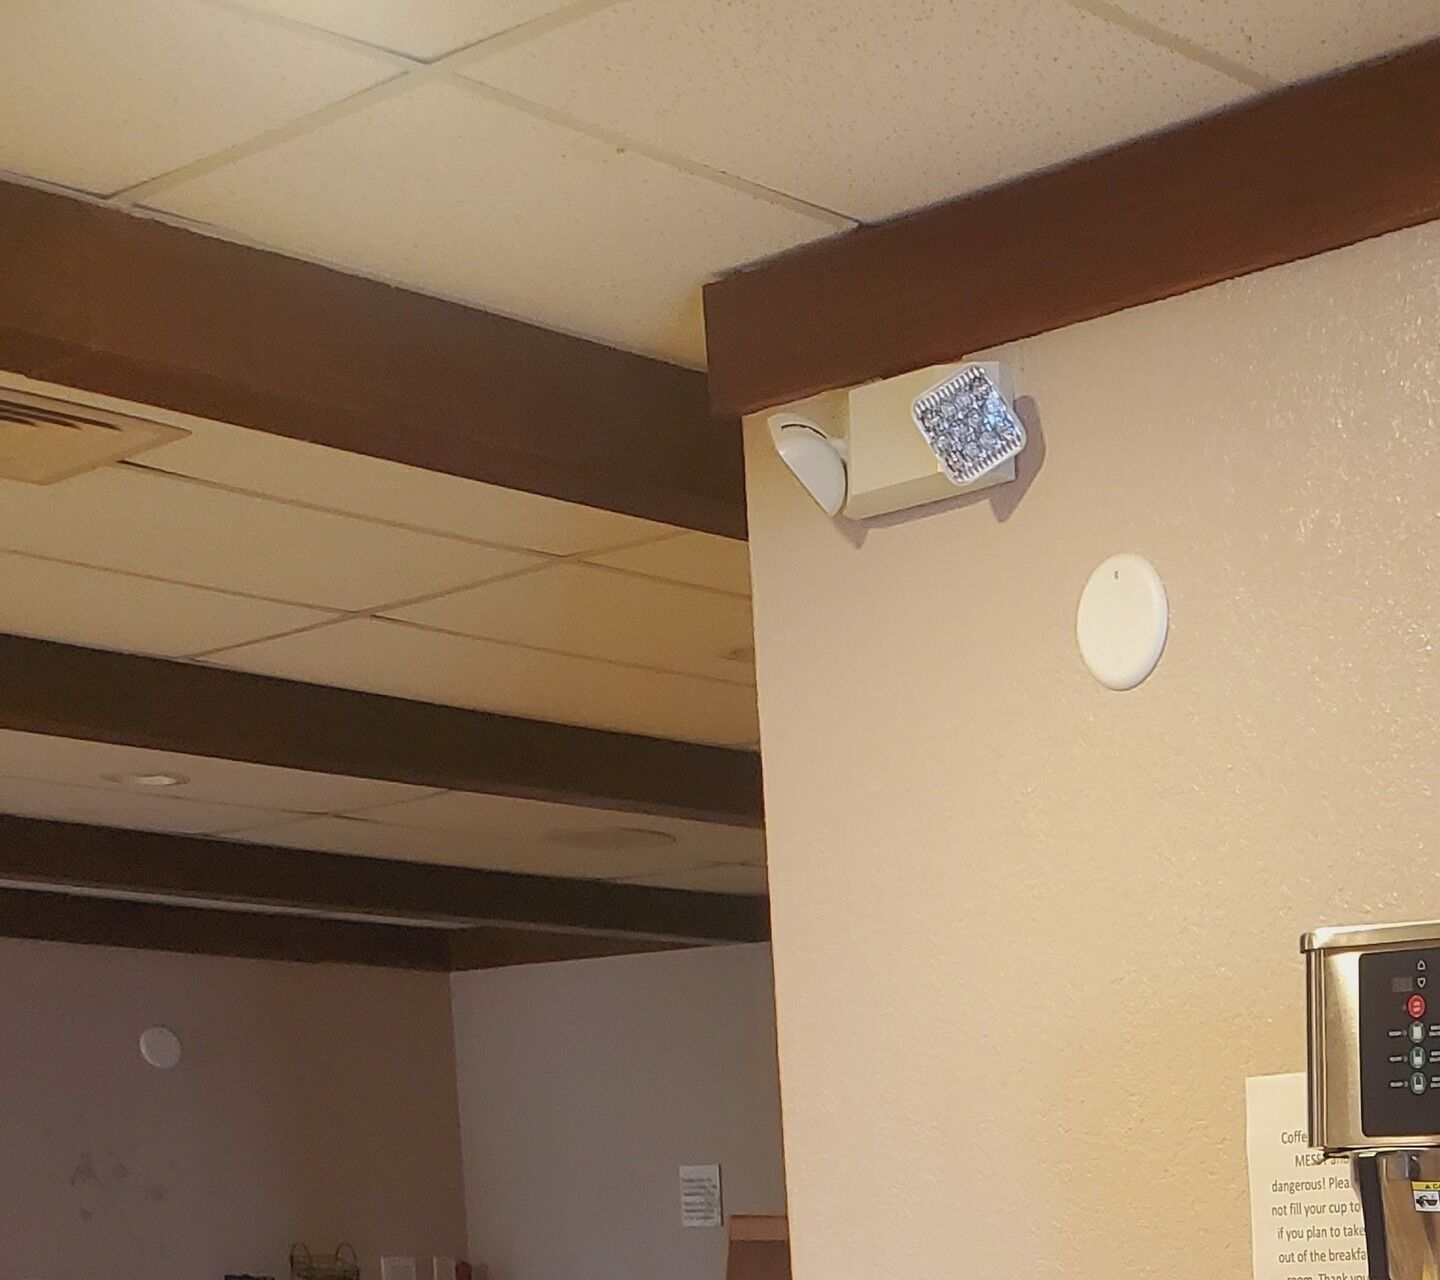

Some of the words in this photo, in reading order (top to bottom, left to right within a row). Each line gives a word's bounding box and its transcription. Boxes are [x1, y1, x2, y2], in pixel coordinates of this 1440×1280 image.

[1281, 1130, 1308, 1144] Coffe
[1271, 1177, 1325, 1194] dangerous!
[1329, 1176, 1350, 1189] Plea
[1271, 1204, 1287, 1216] not
[1290, 1202, 1302, 1215] fill
[1304, 1204, 1326, 1218] your
[1328, 1203, 1347, 1216] cup
[1277, 1226, 1284, 1239] if
[1285, 1229, 1304, 1242] you
[1306, 1225, 1327, 1241] plan
[1330, 1226, 1340, 1238] to
[1343, 1224, 1365, 1237] take
[1278, 1251, 1295, 1263] out
[1297, 1249, 1308, 1263] of
[1310, 1249, 1326, 1262] the
[1328, 1247, 1367, 1262] breakfa
